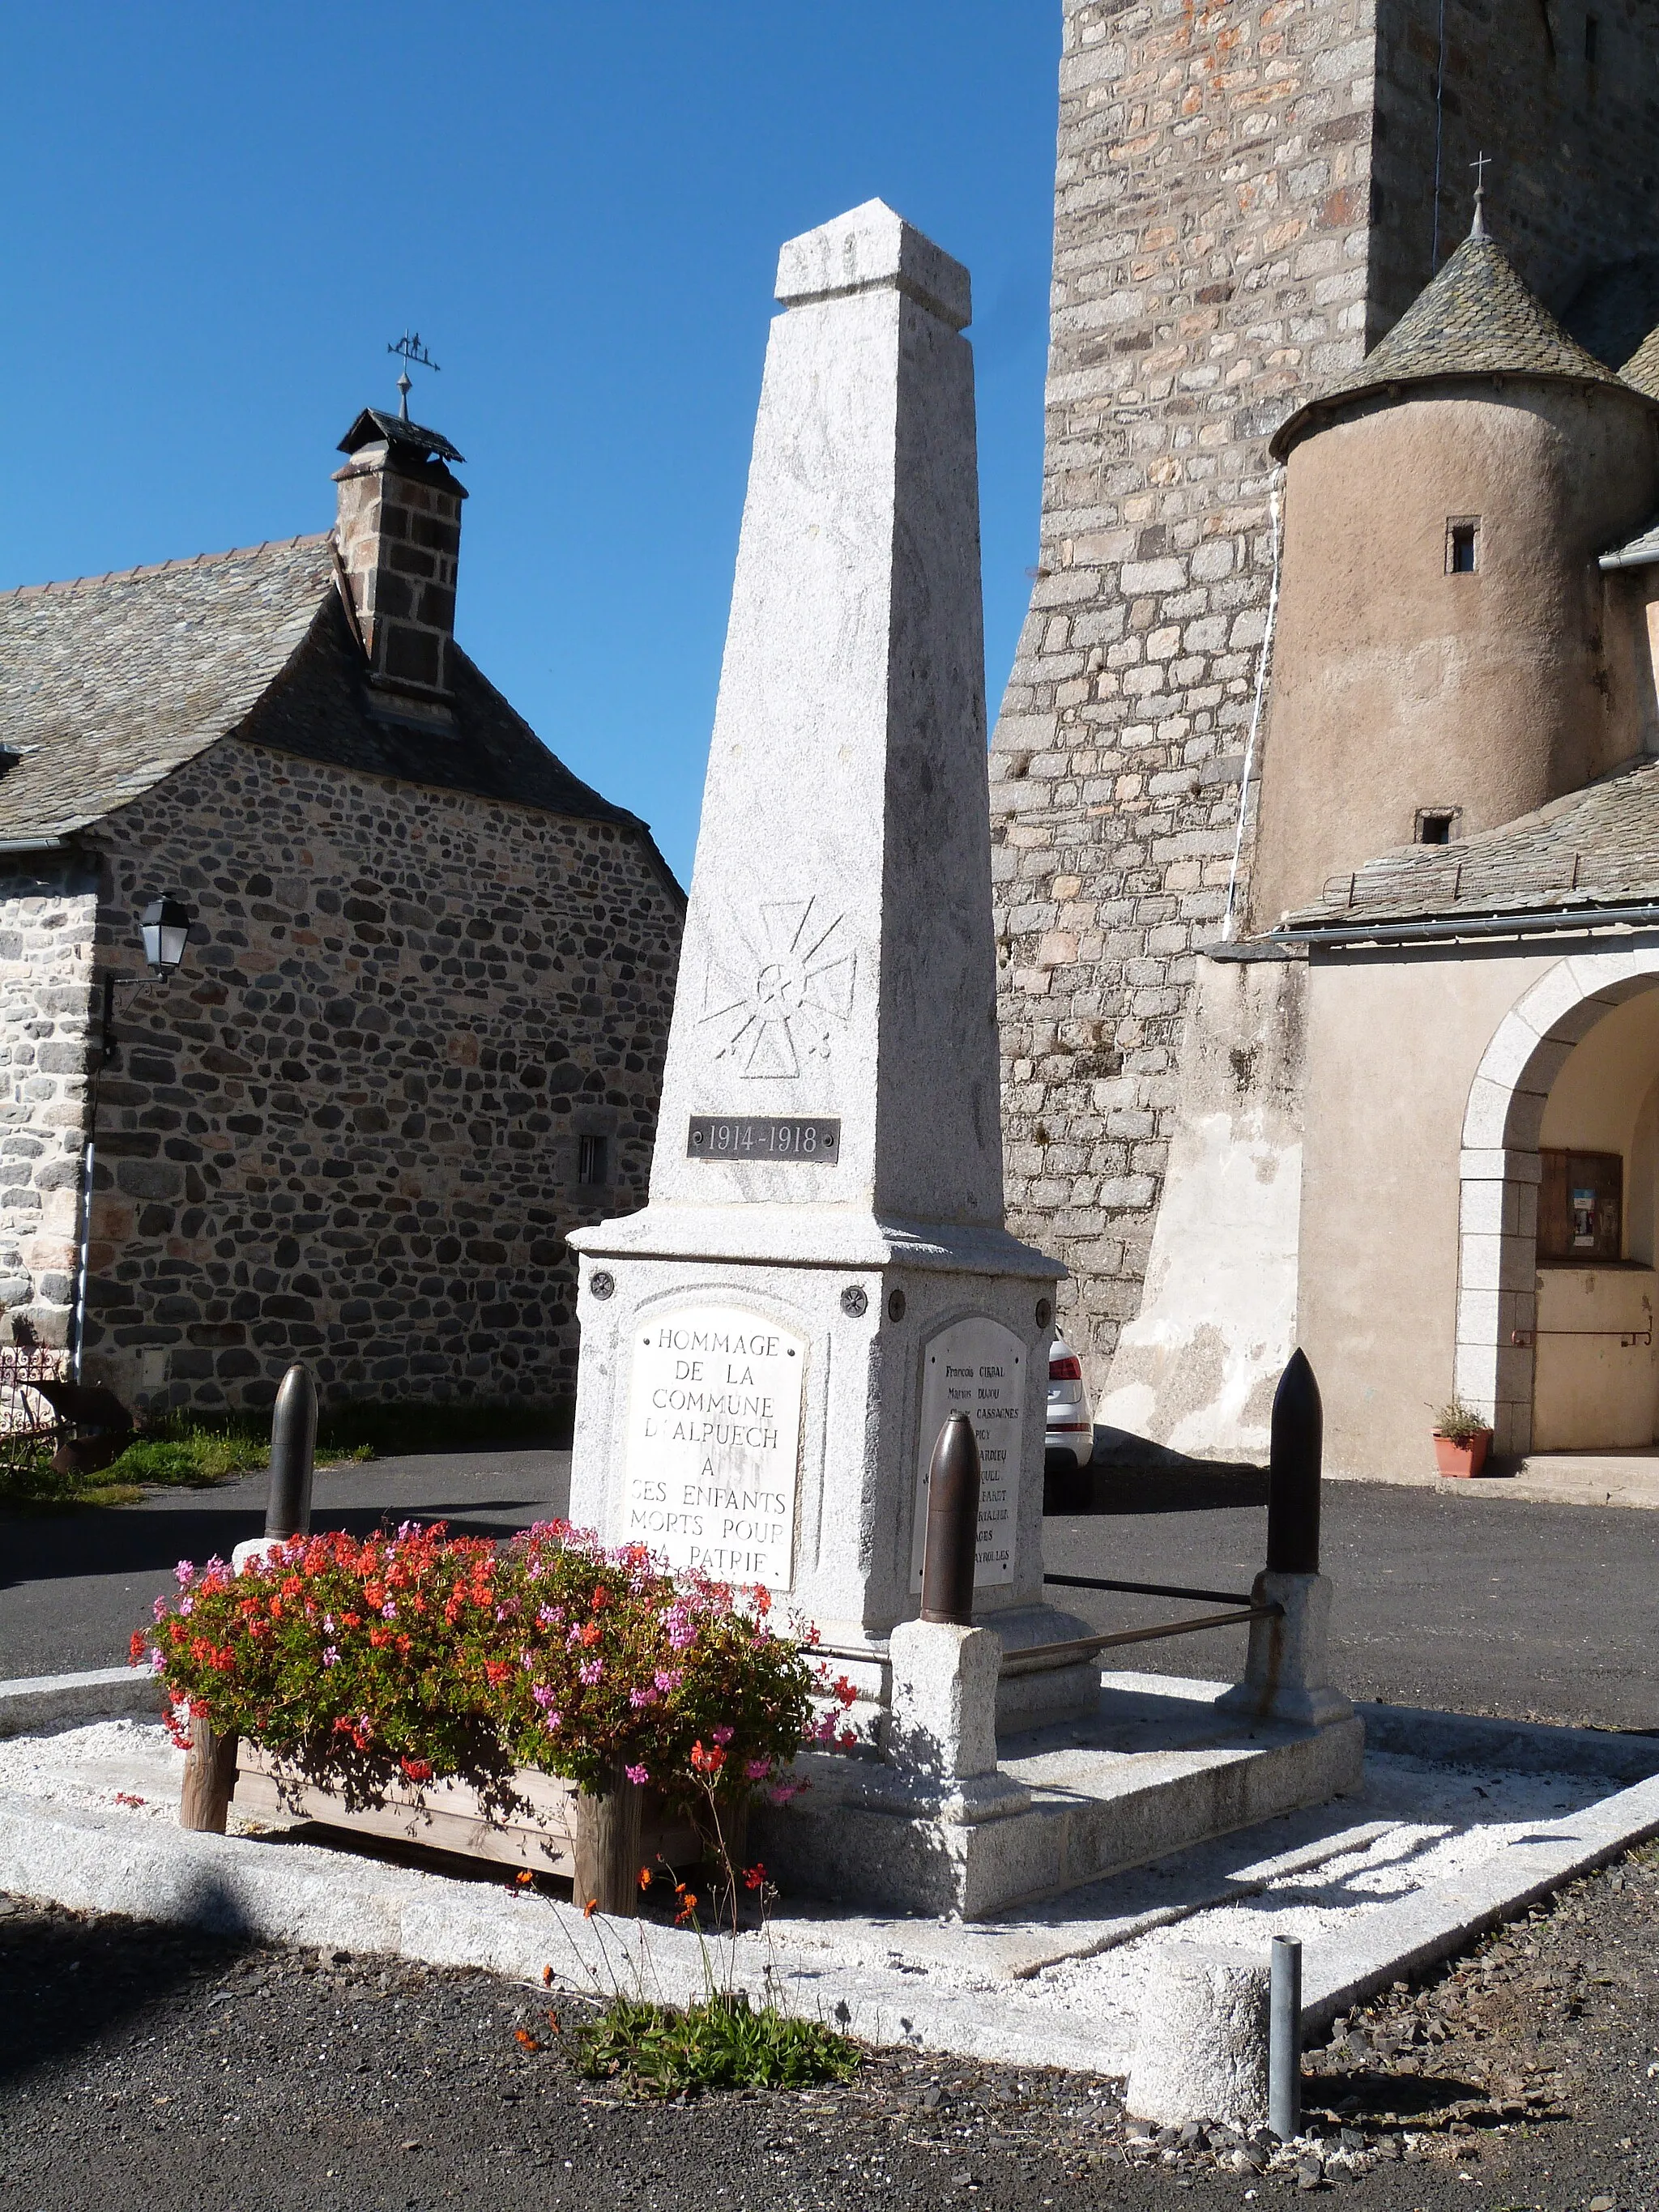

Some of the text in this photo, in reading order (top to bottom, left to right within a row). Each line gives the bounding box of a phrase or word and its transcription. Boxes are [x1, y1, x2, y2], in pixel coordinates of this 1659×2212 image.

[709, 1125, 816, 1153] 1914-1918
[658, 1328, 780, 1357] HOMMAGE
[676, 1361, 754, 1386] DE LA
[652, 1389, 774, 1419] COMMUNE
[702, 1457, 714, 1477] A
[979, 1450, 1007, 1462] ARDIEU
[683, 1485, 786, 1515] ENFANTS
[630, 1510, 784, 1546] MORTS POUR
[690, 1545, 768, 1574] PATRIE
